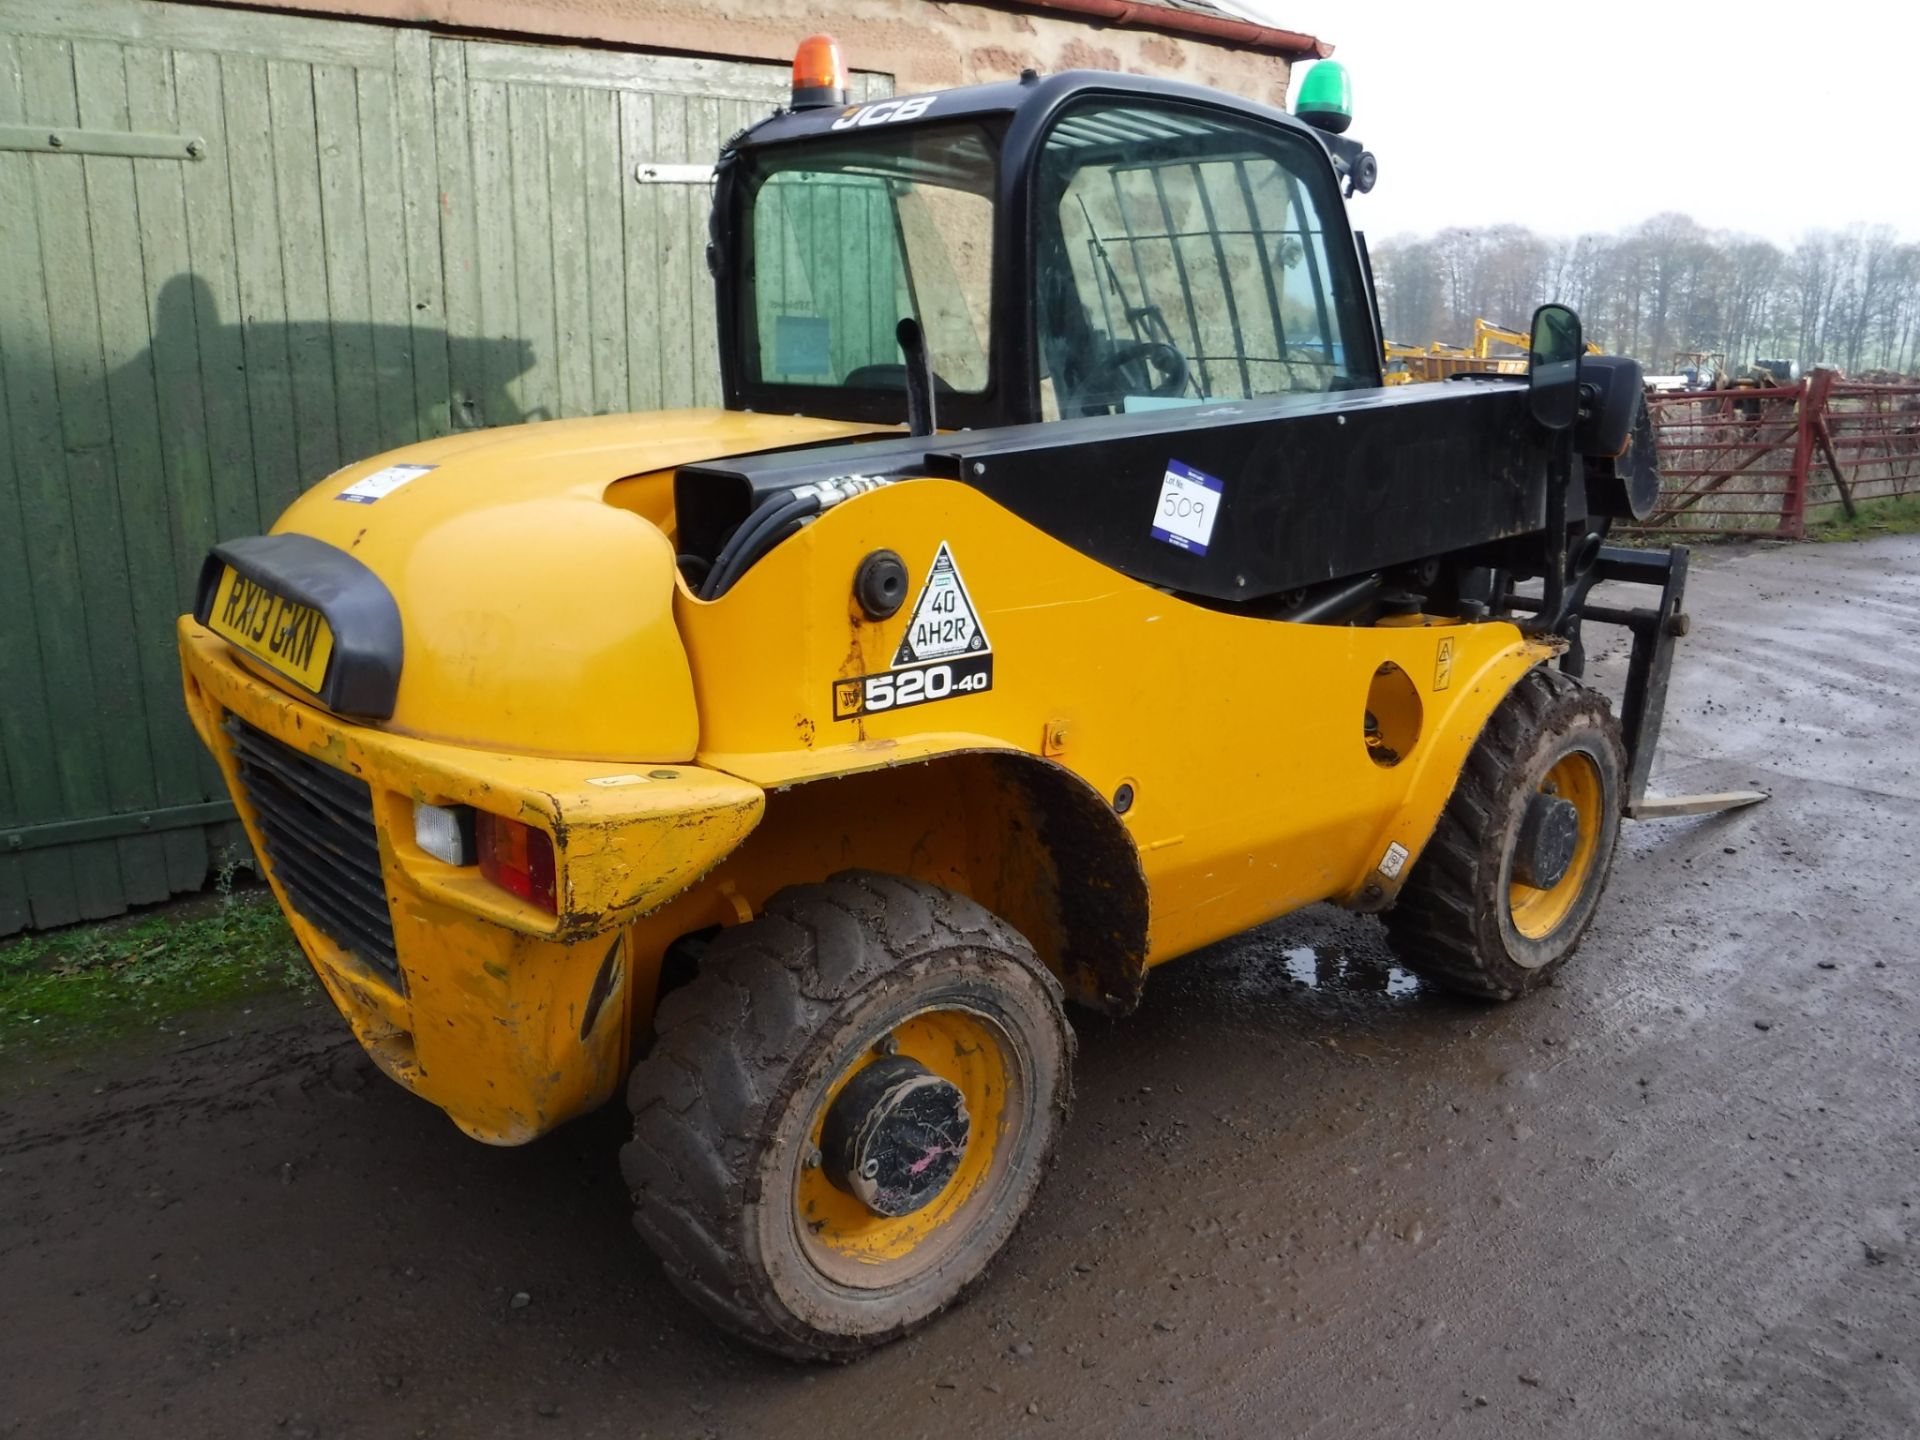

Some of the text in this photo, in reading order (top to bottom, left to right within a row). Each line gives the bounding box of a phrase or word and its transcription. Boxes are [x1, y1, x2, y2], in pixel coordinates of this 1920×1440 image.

[831, 96, 938, 130] JCB
[1164, 492, 1205, 528] 509
[932, 590, 954, 614] 40
[222, 575, 322, 672] RX13 GKN
[916, 617, 966, 647] AH2R
